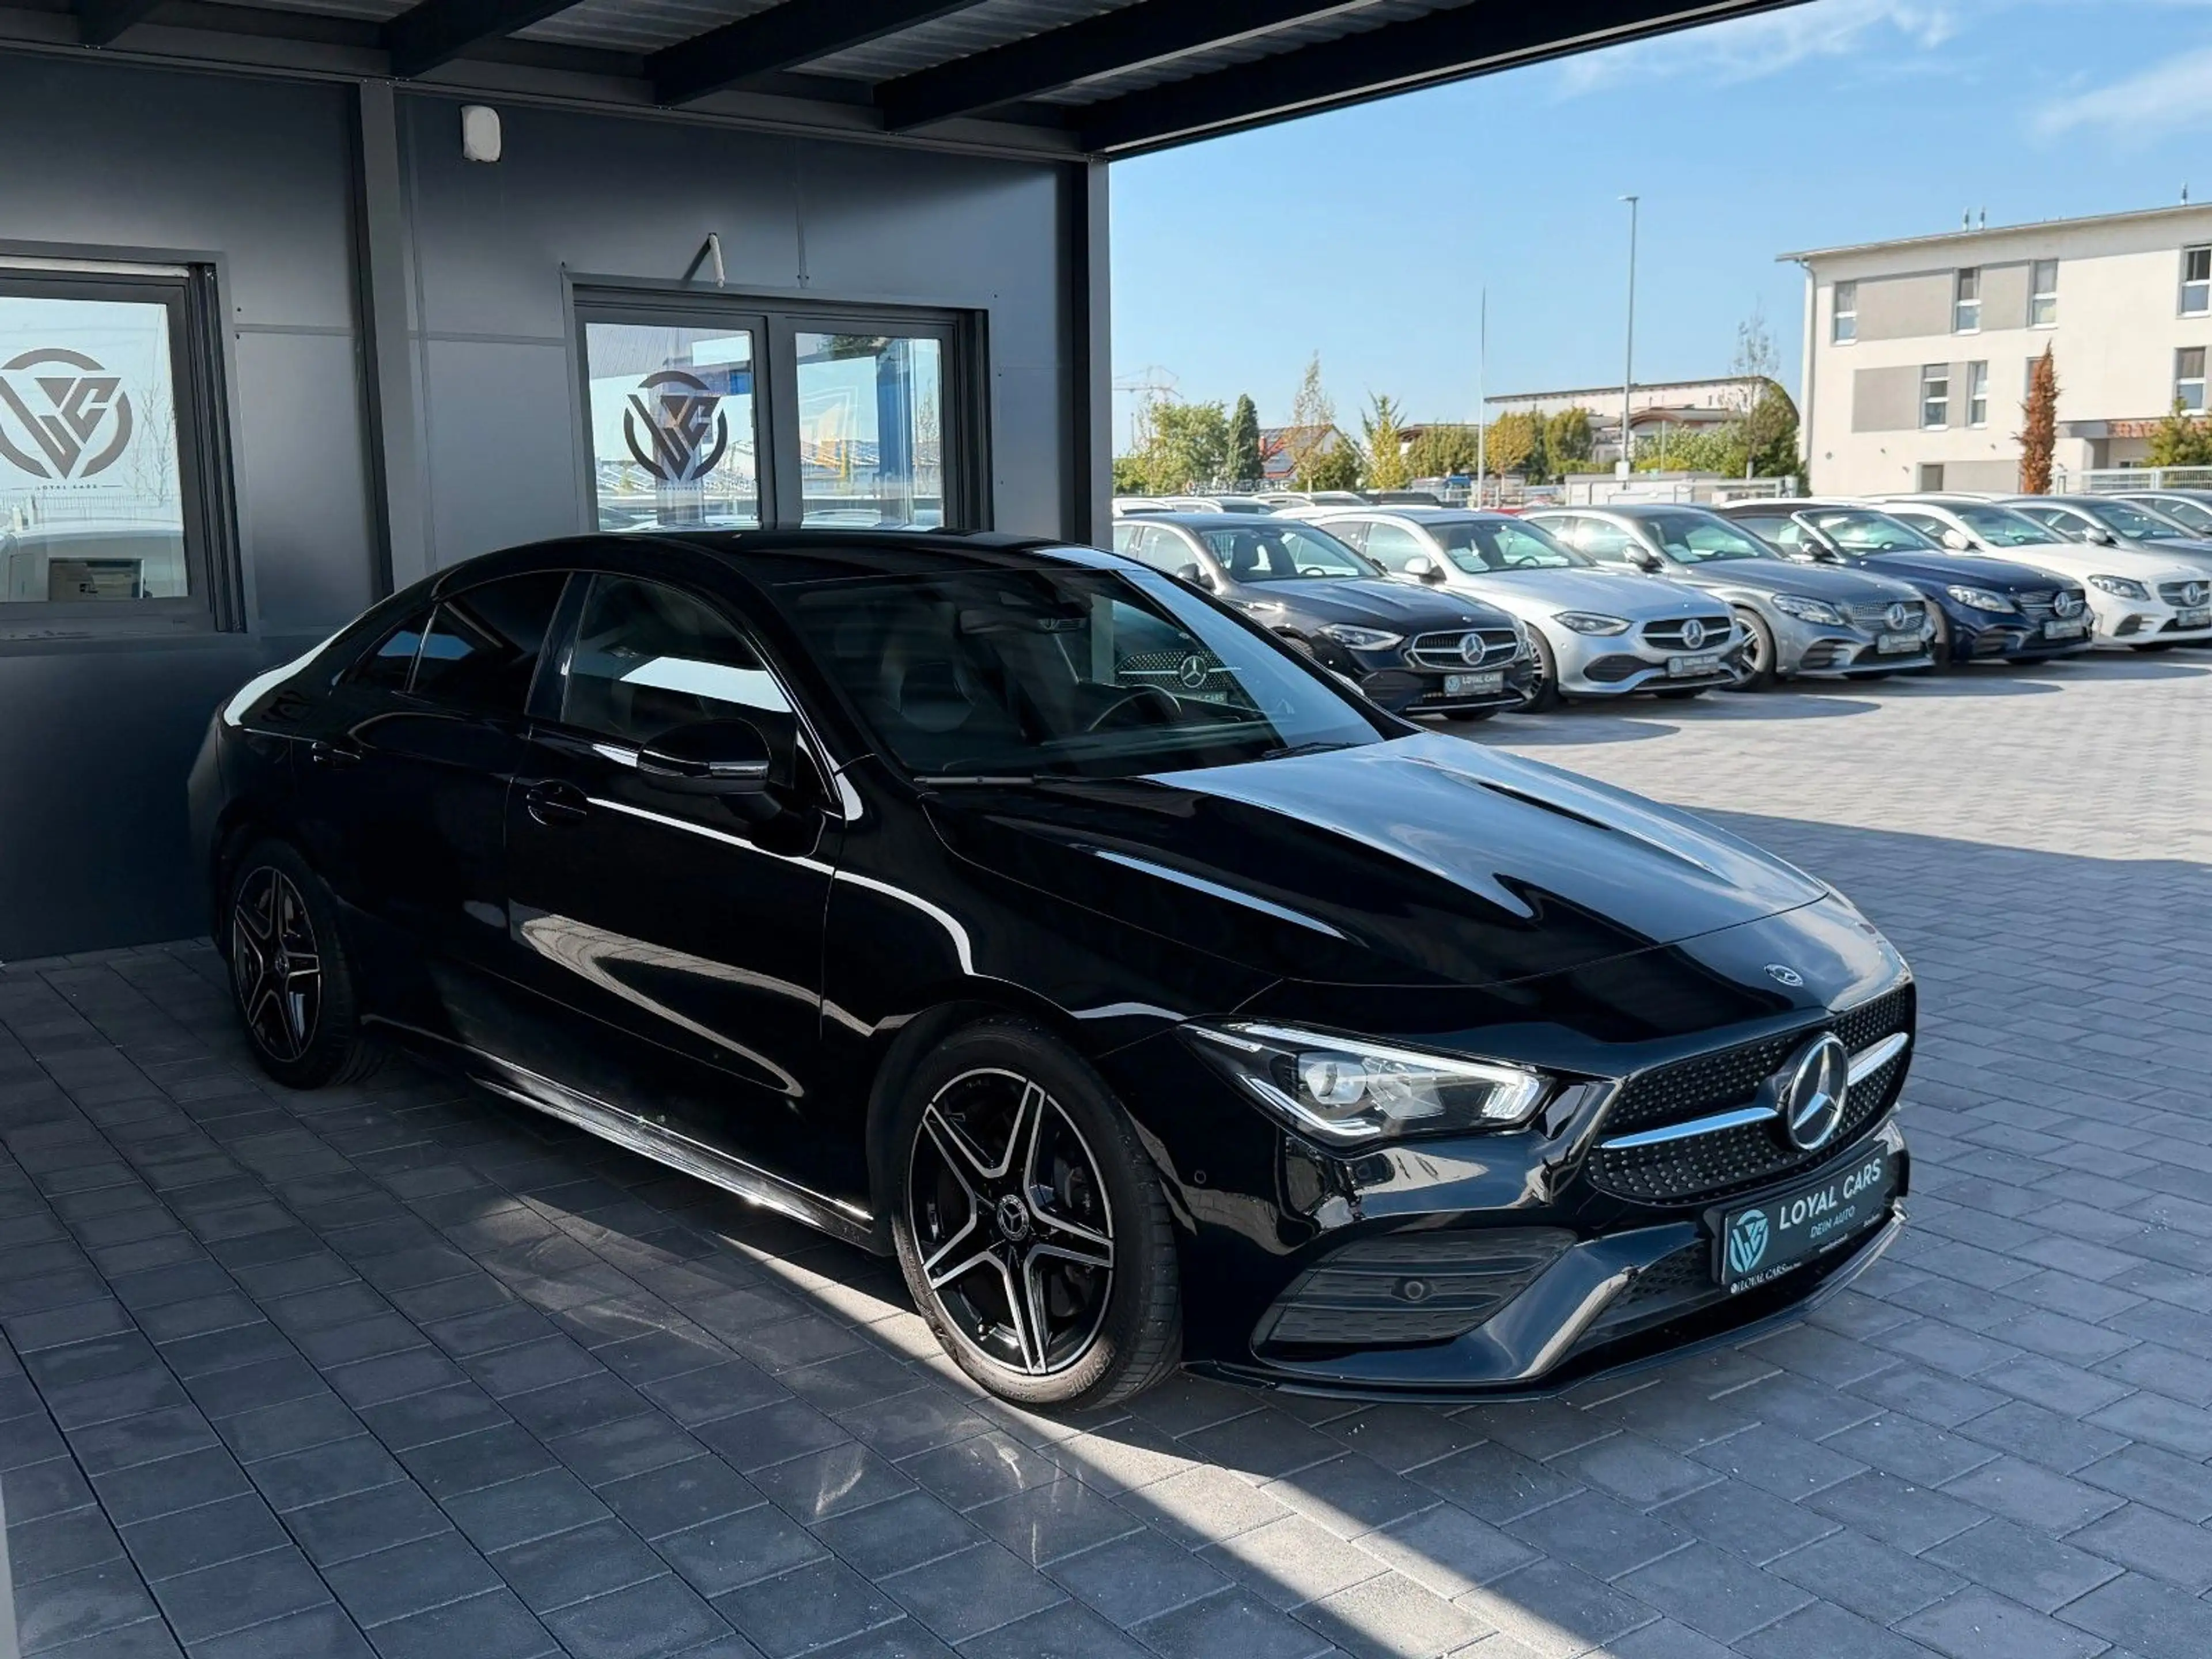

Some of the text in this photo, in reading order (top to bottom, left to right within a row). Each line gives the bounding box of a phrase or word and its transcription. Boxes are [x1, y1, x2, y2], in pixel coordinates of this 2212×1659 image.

[1779, 1158, 1882, 1231] LOYAL CARS
[1832, 1205, 1856, 1227] AUTO
